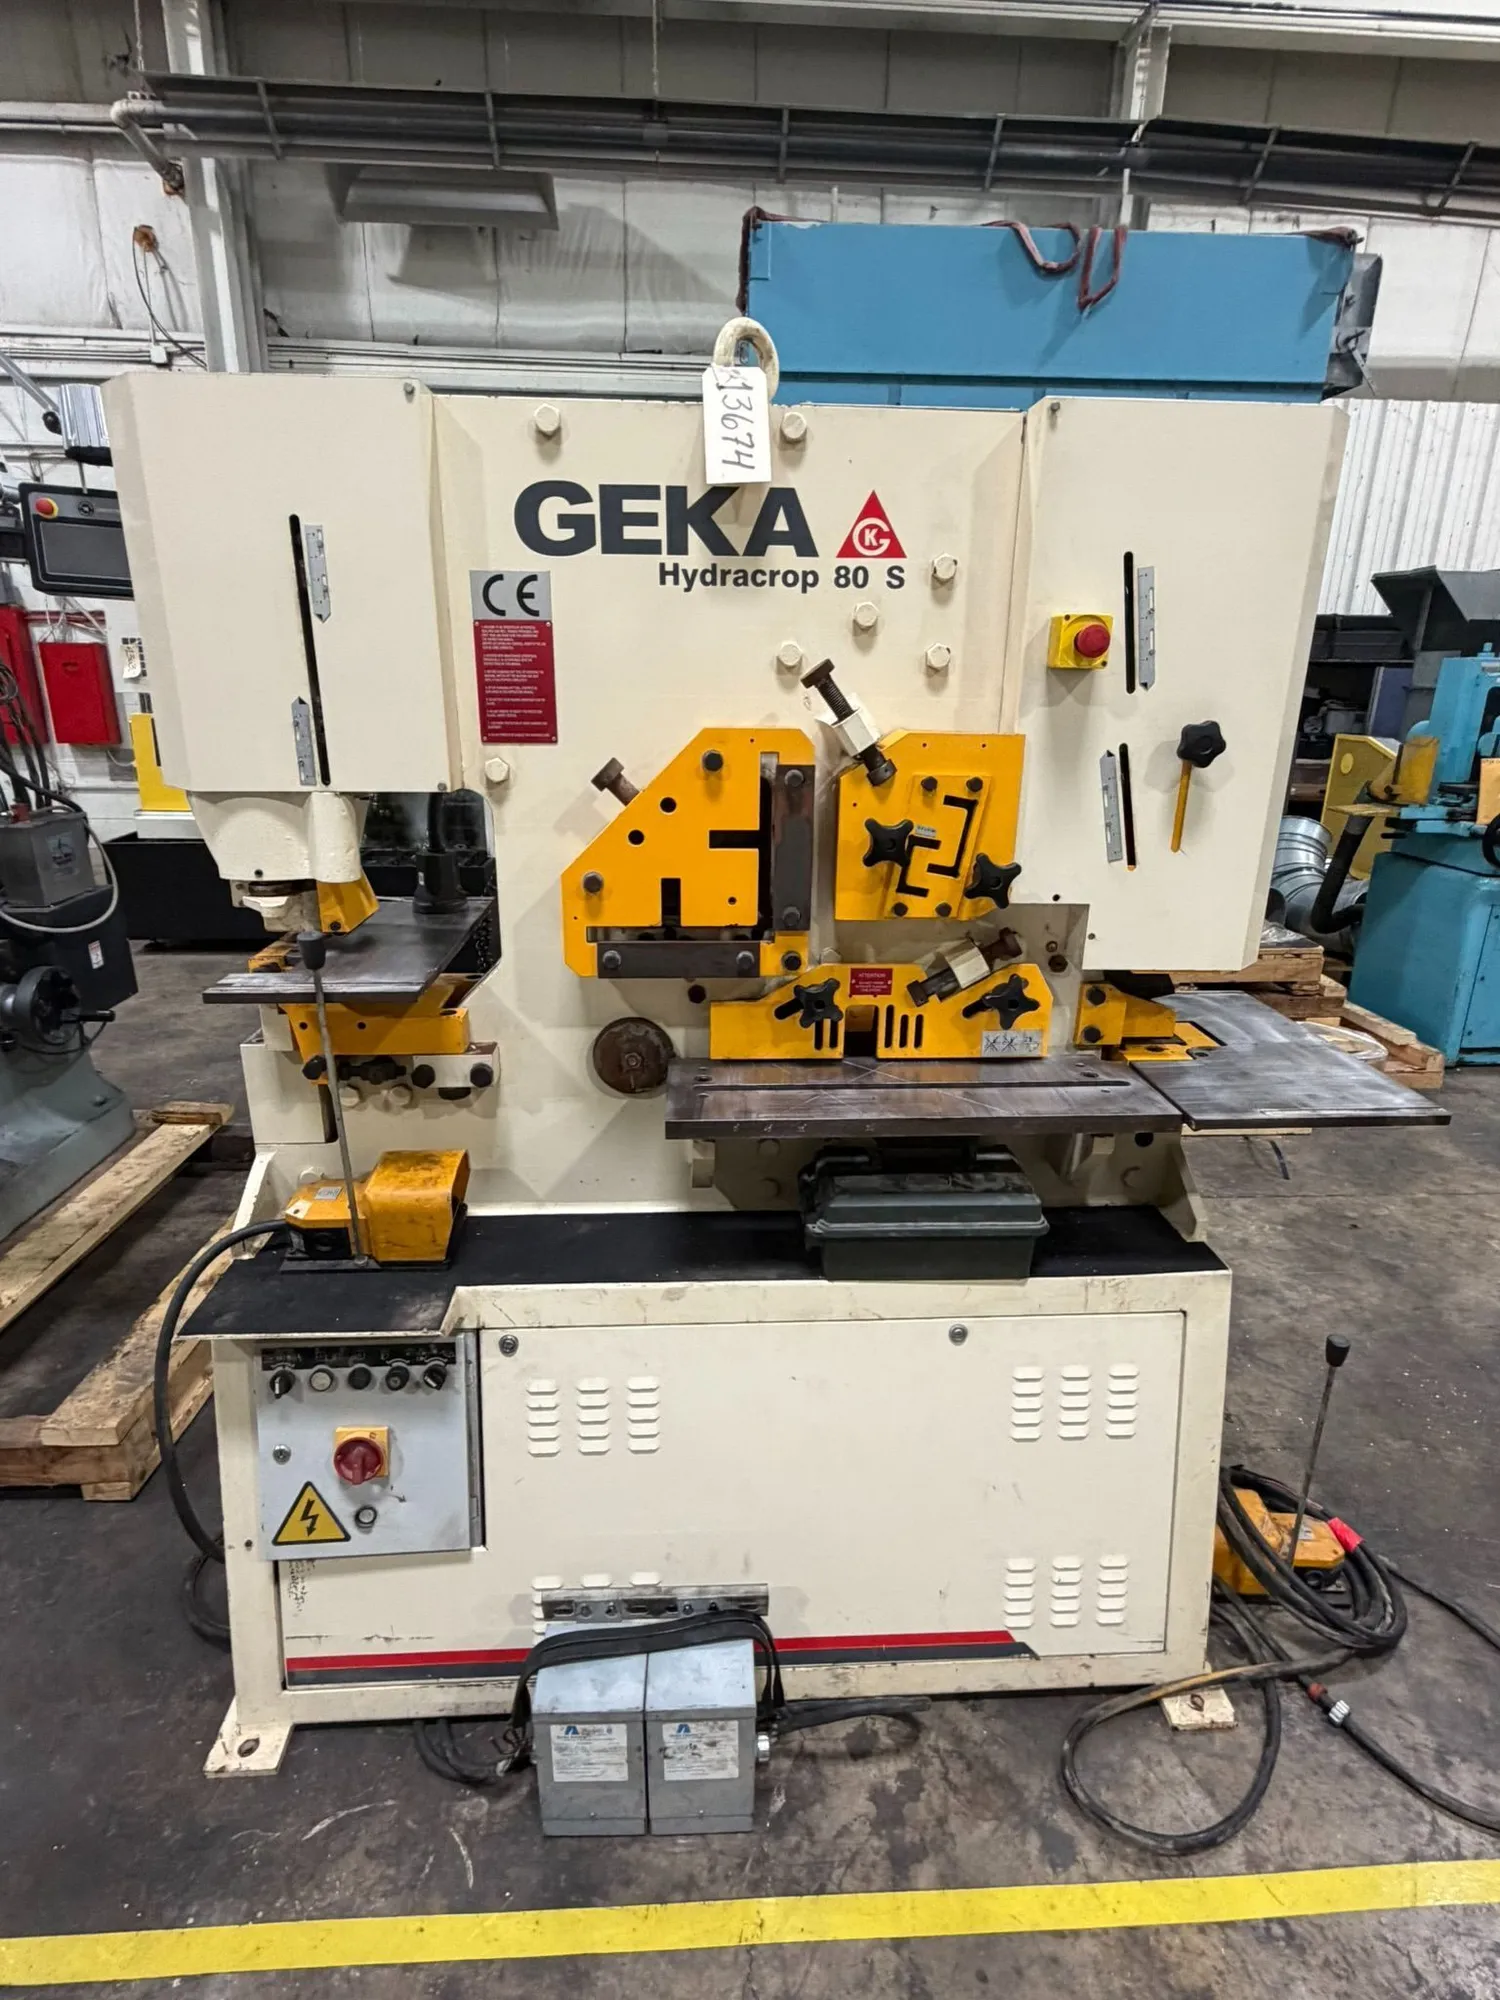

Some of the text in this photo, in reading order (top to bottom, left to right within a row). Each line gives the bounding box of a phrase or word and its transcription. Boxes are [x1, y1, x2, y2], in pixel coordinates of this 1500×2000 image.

[715, 382, 756, 470] 13674
[514, 480, 820, 558] GEKA
[482, 573, 540, 618] CE
[659, 562, 905, 594] Hydracrop 80 S
